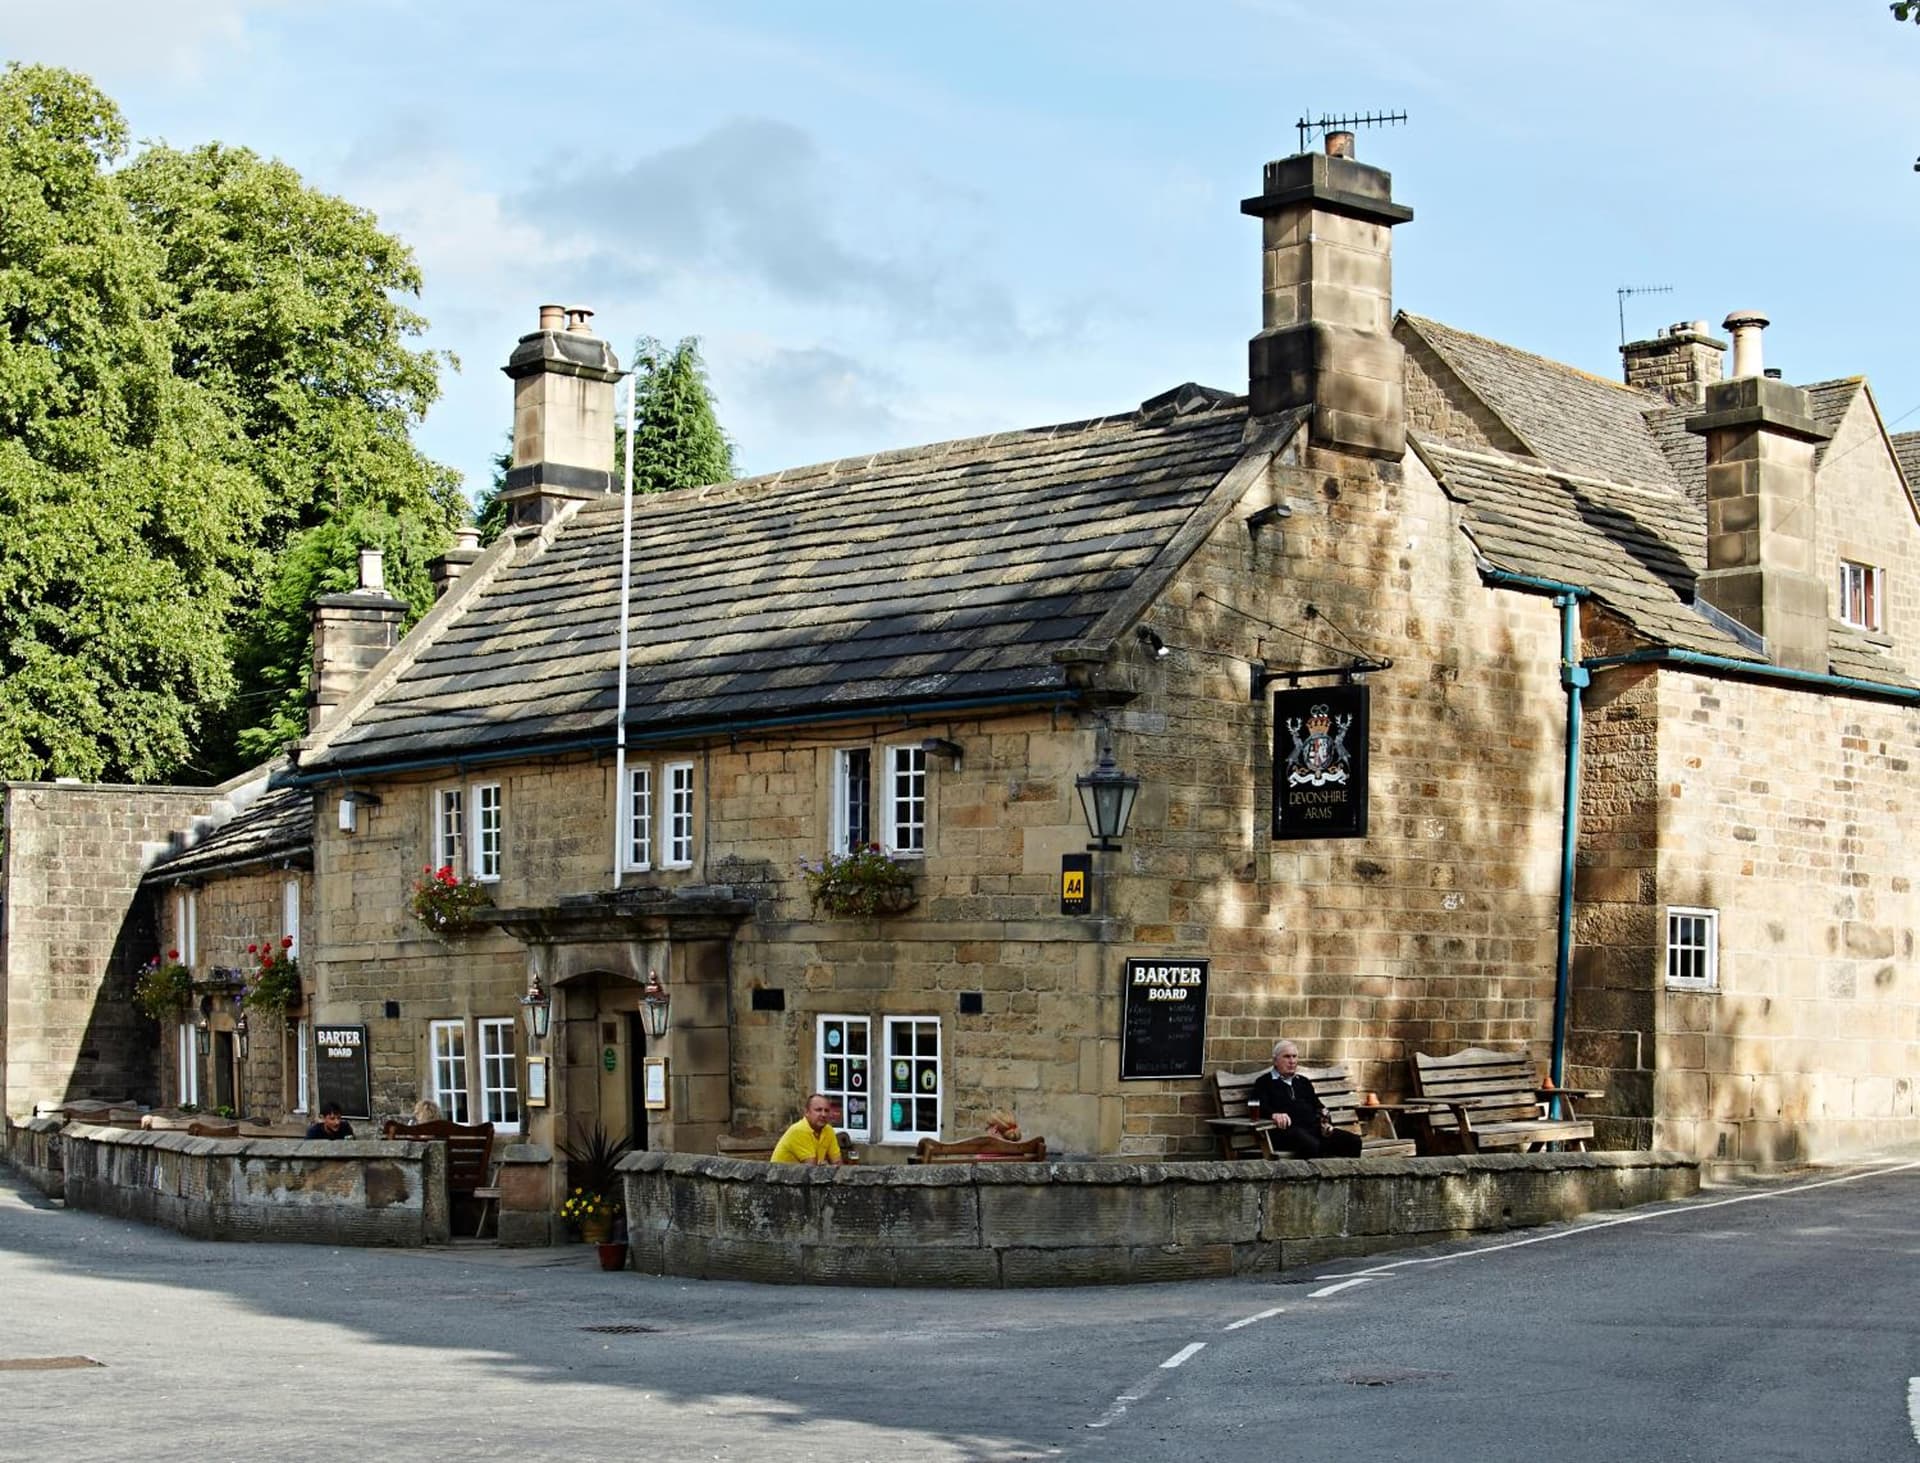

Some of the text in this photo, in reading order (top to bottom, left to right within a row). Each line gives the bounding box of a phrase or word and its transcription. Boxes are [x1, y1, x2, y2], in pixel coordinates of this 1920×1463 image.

[1289, 789, 1348, 805] DEVONSHIRE
[1304, 807, 1332, 819] ARMS
[1066, 879, 1081, 894] AA
[1133, 967, 1201, 987] BARTER
[1148, 988, 1188, 1001] BOARD
[318, 1031, 360, 1047] BARTER
[328, 1048, 352, 1058] BOARD
